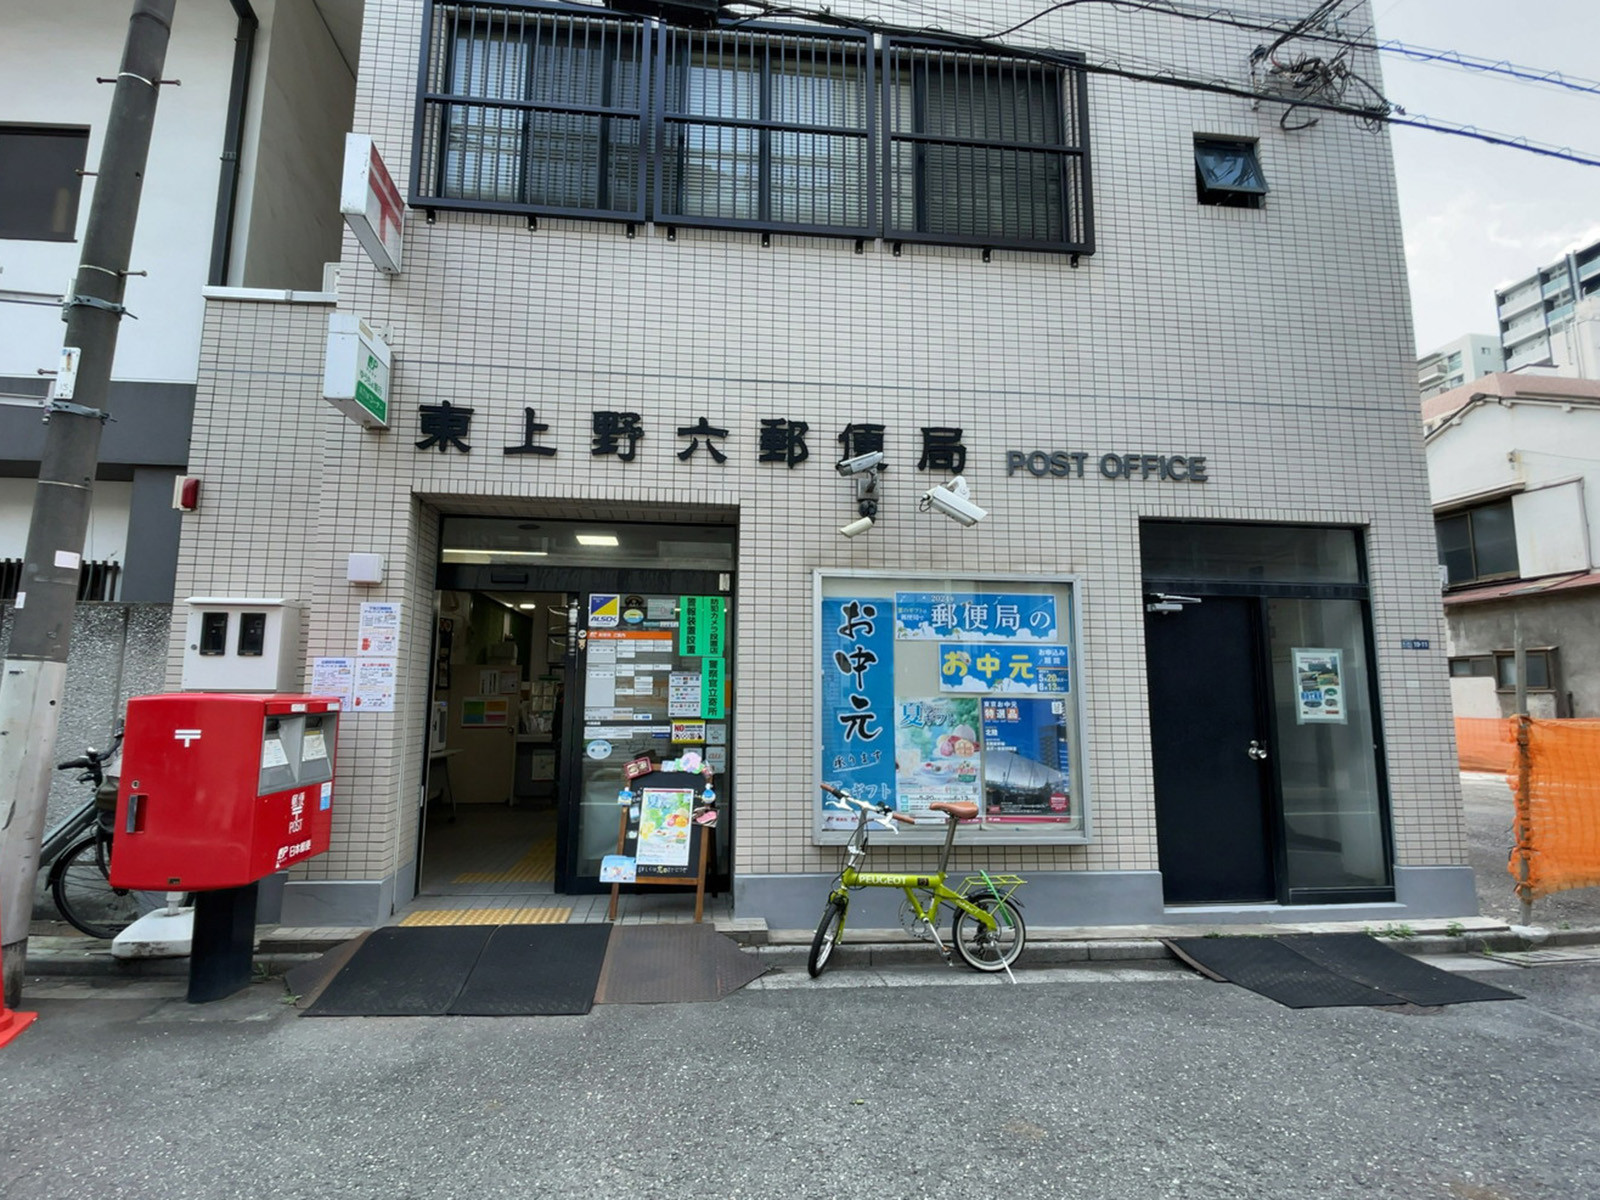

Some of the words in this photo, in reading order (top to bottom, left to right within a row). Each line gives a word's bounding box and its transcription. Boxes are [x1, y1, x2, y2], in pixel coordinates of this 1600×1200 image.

[415, 400, 967, 474] 東上野六郵便局
[1007, 450, 1089, 478] POST
[1100, 453, 1208, 481] OFFICE
[930, 602, 1051, 630] 郵便局の
[833, 599, 884, 742] お中元
[942, 651, 1035, 679] お中元
[984, 708, 1018, 719] 特選品
[288, 818, 304, 835] POST
[859, 874, 907, 884] PEUGEOT
